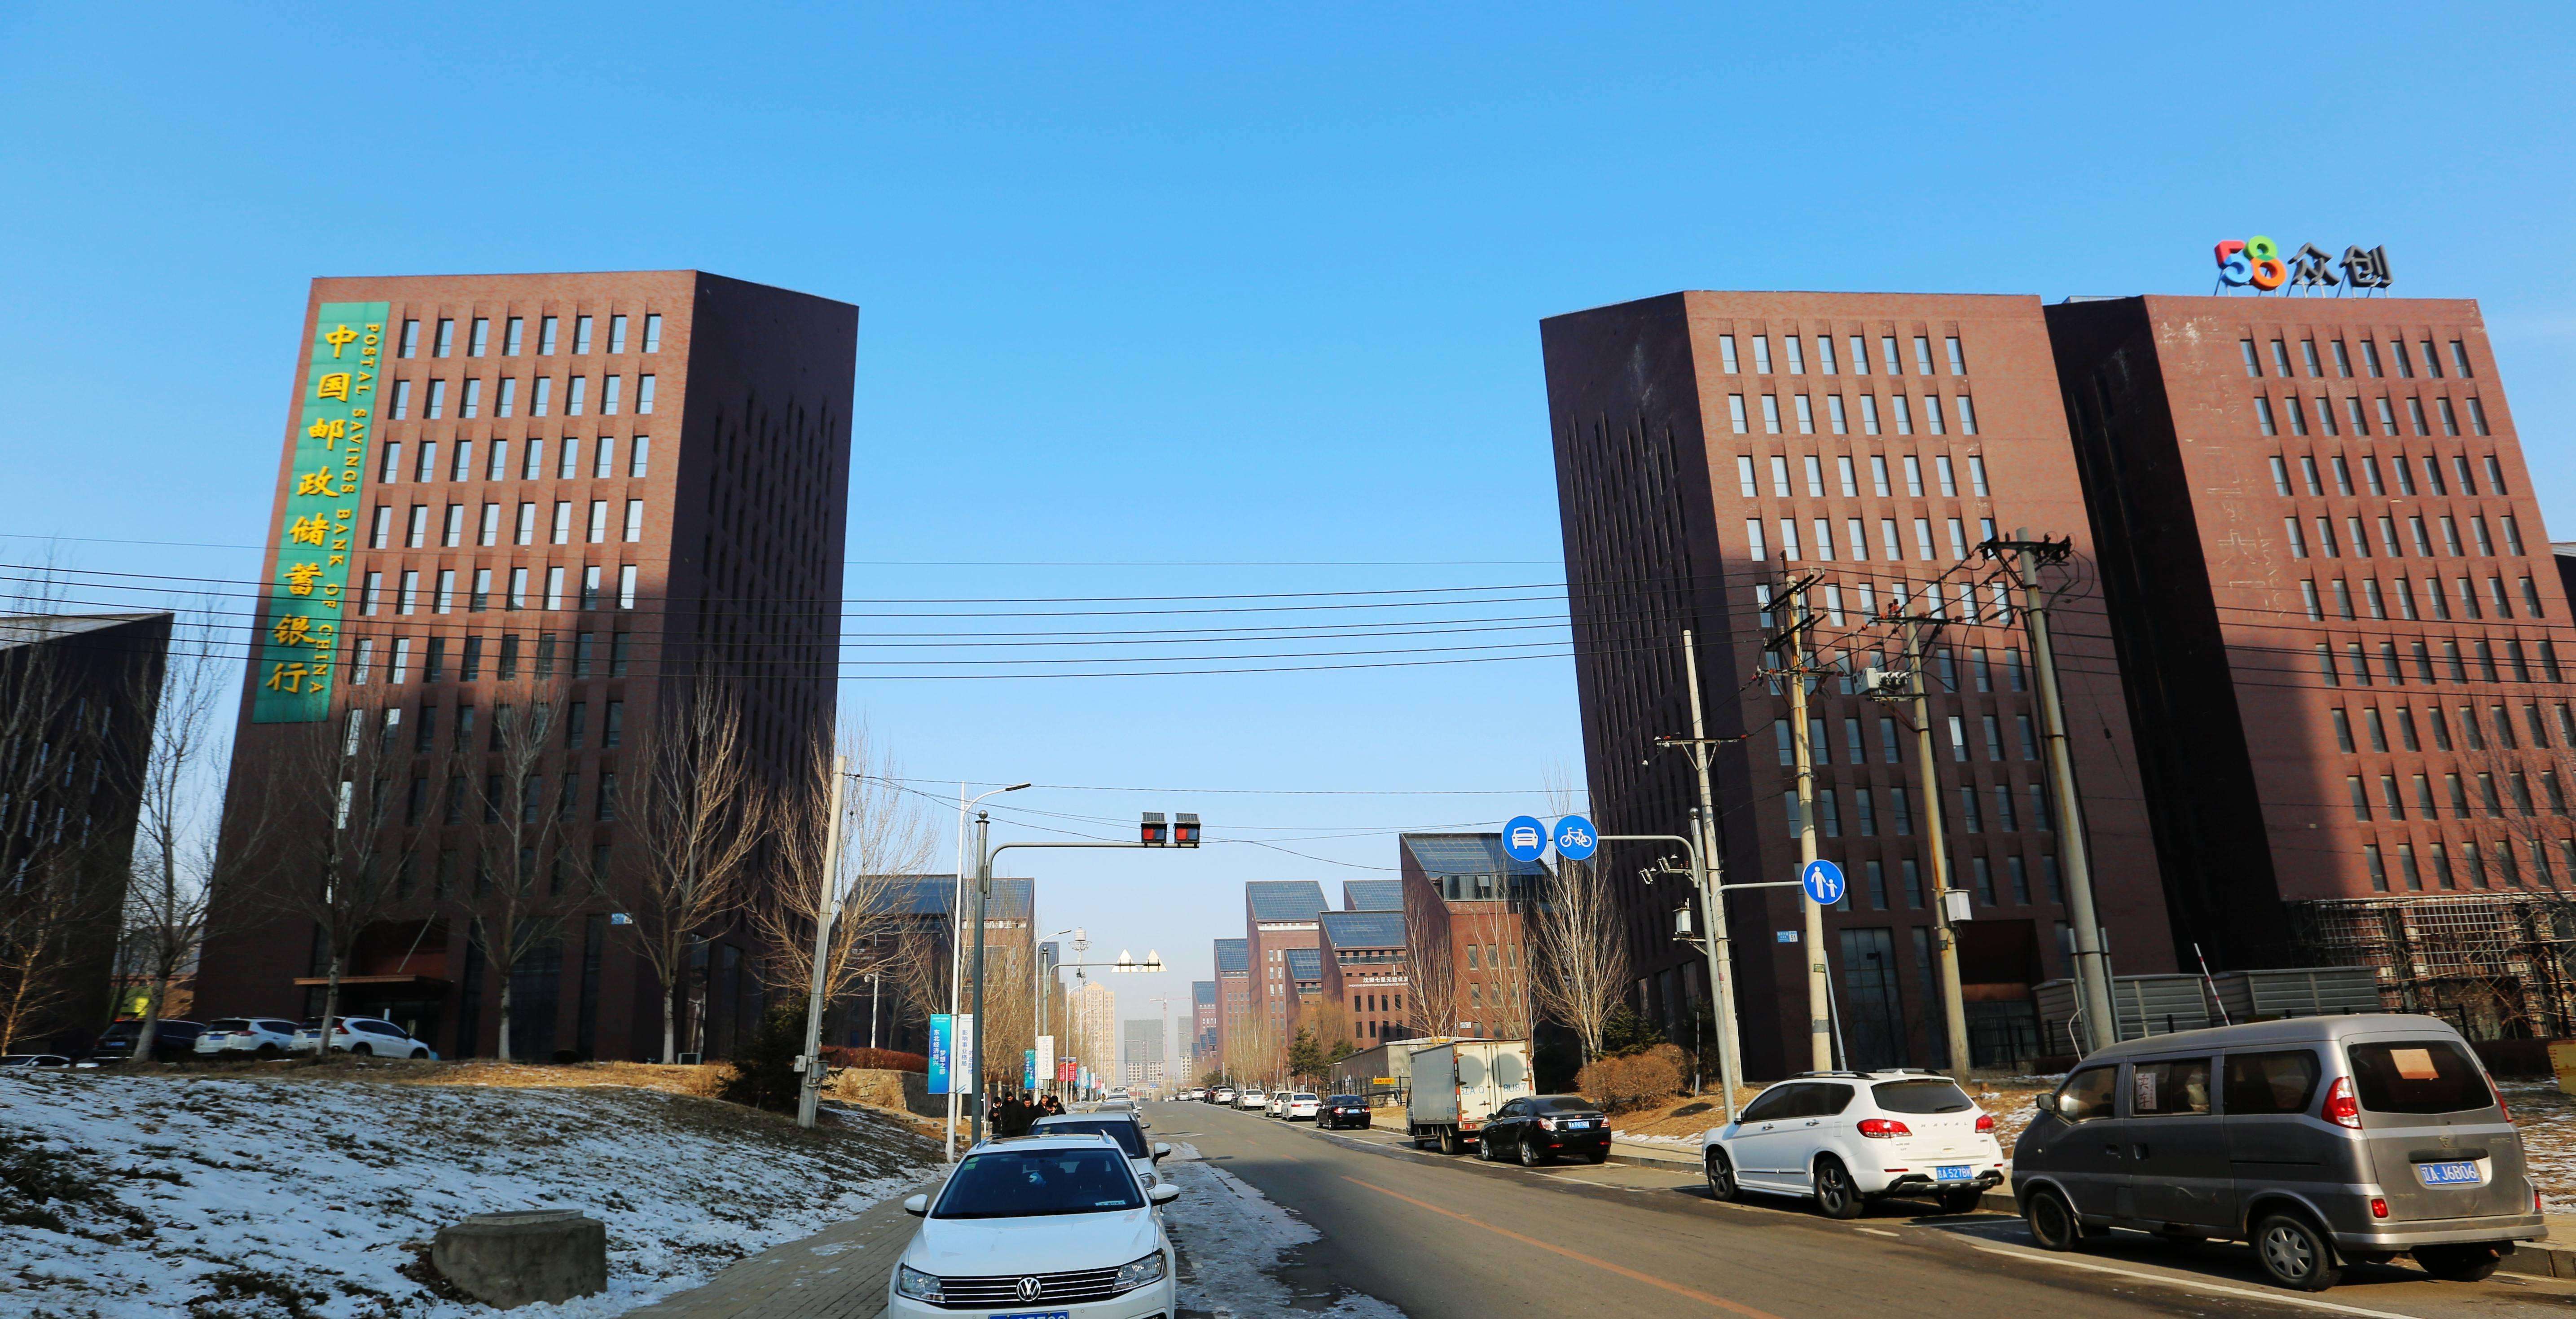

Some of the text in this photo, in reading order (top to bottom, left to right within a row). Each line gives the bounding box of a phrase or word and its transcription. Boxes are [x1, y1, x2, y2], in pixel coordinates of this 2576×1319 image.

[265, 324, 359, 693] 中国邮政储蓄银行
[309, 324, 381, 693] POSTAL SAVINGS BANK OF CHINA
